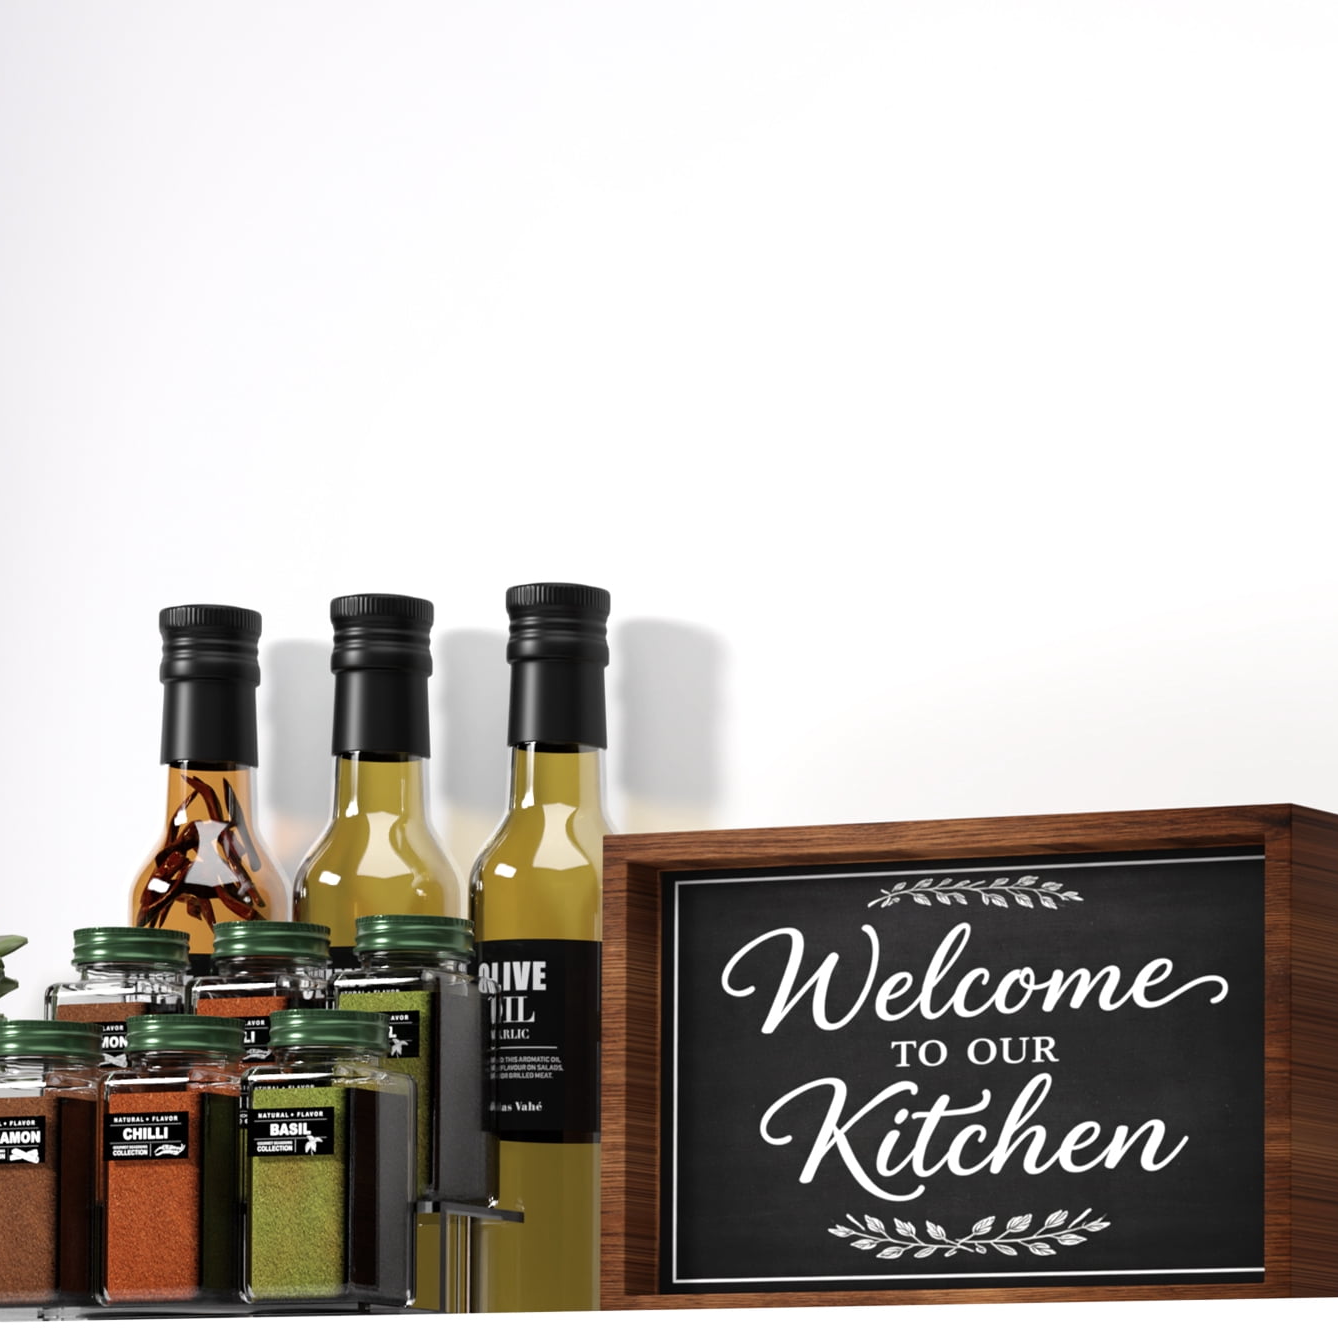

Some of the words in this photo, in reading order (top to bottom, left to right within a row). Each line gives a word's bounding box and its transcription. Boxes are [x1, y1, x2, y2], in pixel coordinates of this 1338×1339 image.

[721, 922, 1229, 1034] Welcome
[890, 1038, 948, 1068] TO
[967, 1036, 1060, 1065] OUR
[515, 1100, 543, 1112] Vahé
[257, 1111, 289, 1119] NATURAL
[296, 1110, 324, 1118] FLAVOR
[9, 1119, 36, 1127] FLAVOR
[269, 1122, 312, 1136] BASIL
[122, 1126, 169, 1141] CHILLI
[759, 1072, 1189, 1202] Kitchen
[112, 1149, 148, 1157] COLLECTION
